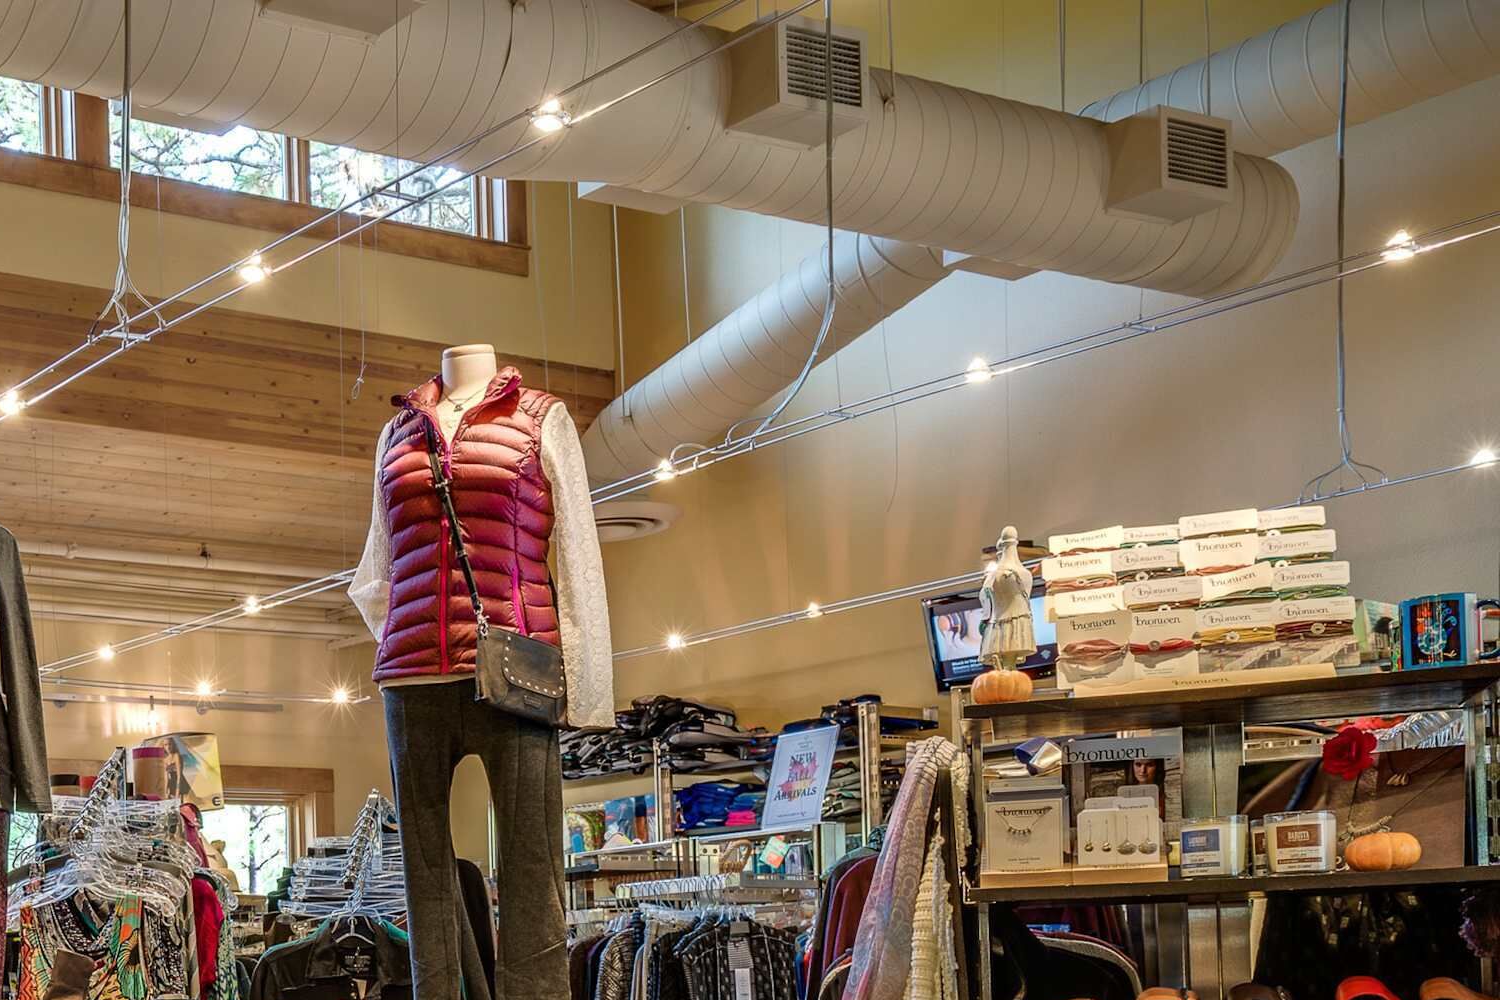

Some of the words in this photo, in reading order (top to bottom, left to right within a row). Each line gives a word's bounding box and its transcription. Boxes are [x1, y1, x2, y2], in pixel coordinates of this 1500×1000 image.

[1209, 613, 1252, 625] bronwen
[1285, 606, 1331, 617] bronwen
[1070, 616, 1117, 631] bronwen
[1134, 616, 1181, 627] bronwen
[789, 751, 816, 768] NEW
[1061, 744, 1148, 763] bronwen
[773, 786, 818, 801] ARRIVALS
